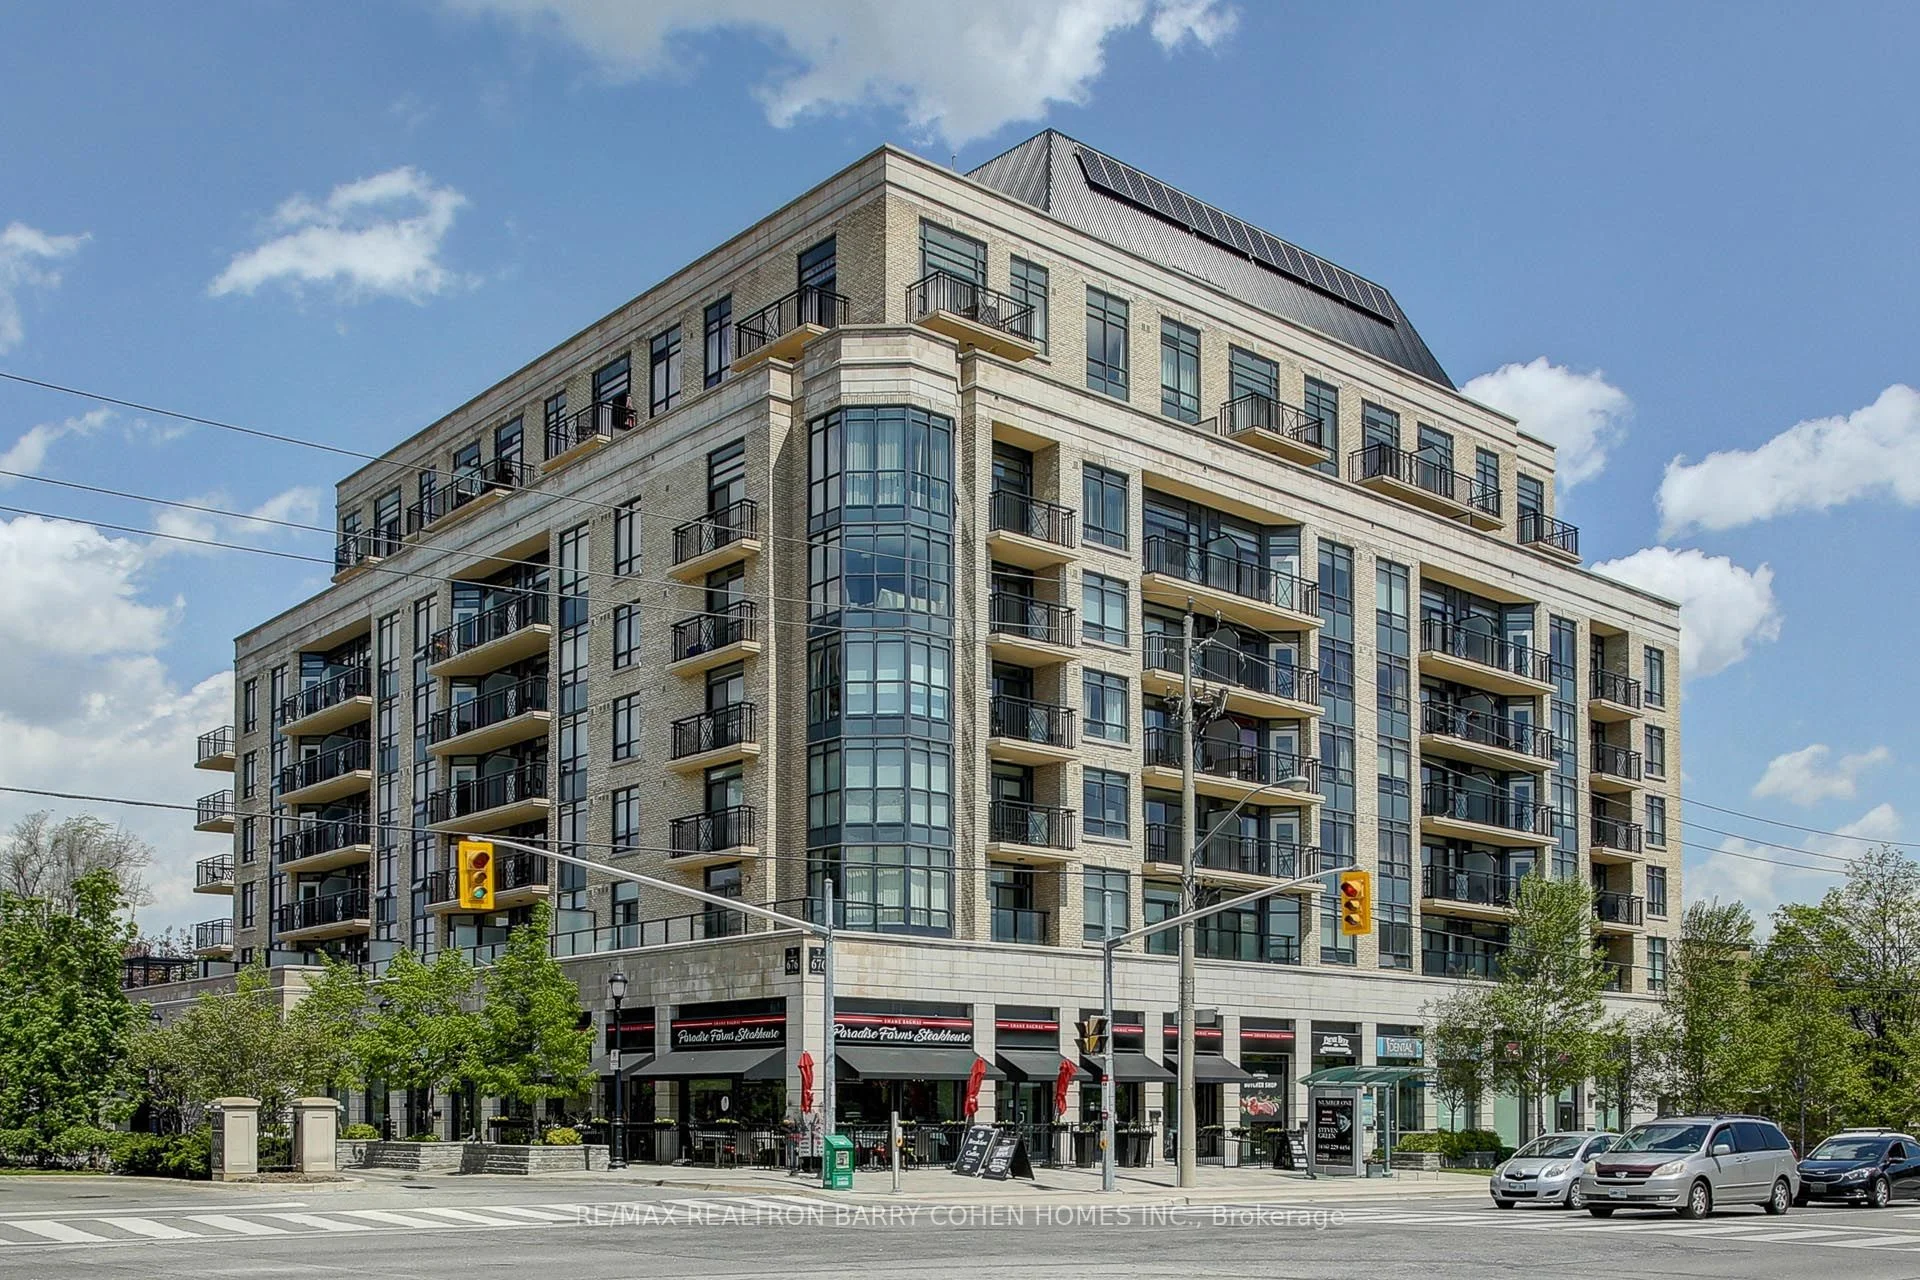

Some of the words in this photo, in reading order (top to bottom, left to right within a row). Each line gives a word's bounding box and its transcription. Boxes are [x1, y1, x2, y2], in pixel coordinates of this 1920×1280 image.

[678, 1029, 709, 1044] Paradise
[710, 1028, 734, 1043] Farms
[734, 1027, 779, 1042] Steakhouse
[833, 1024, 878, 1039] Paradise
[879, 1026, 914, 1041] Farms
[913, 1028, 971, 1042] Steakhouse
[1389, 1042, 1413, 1053] DENTAL
